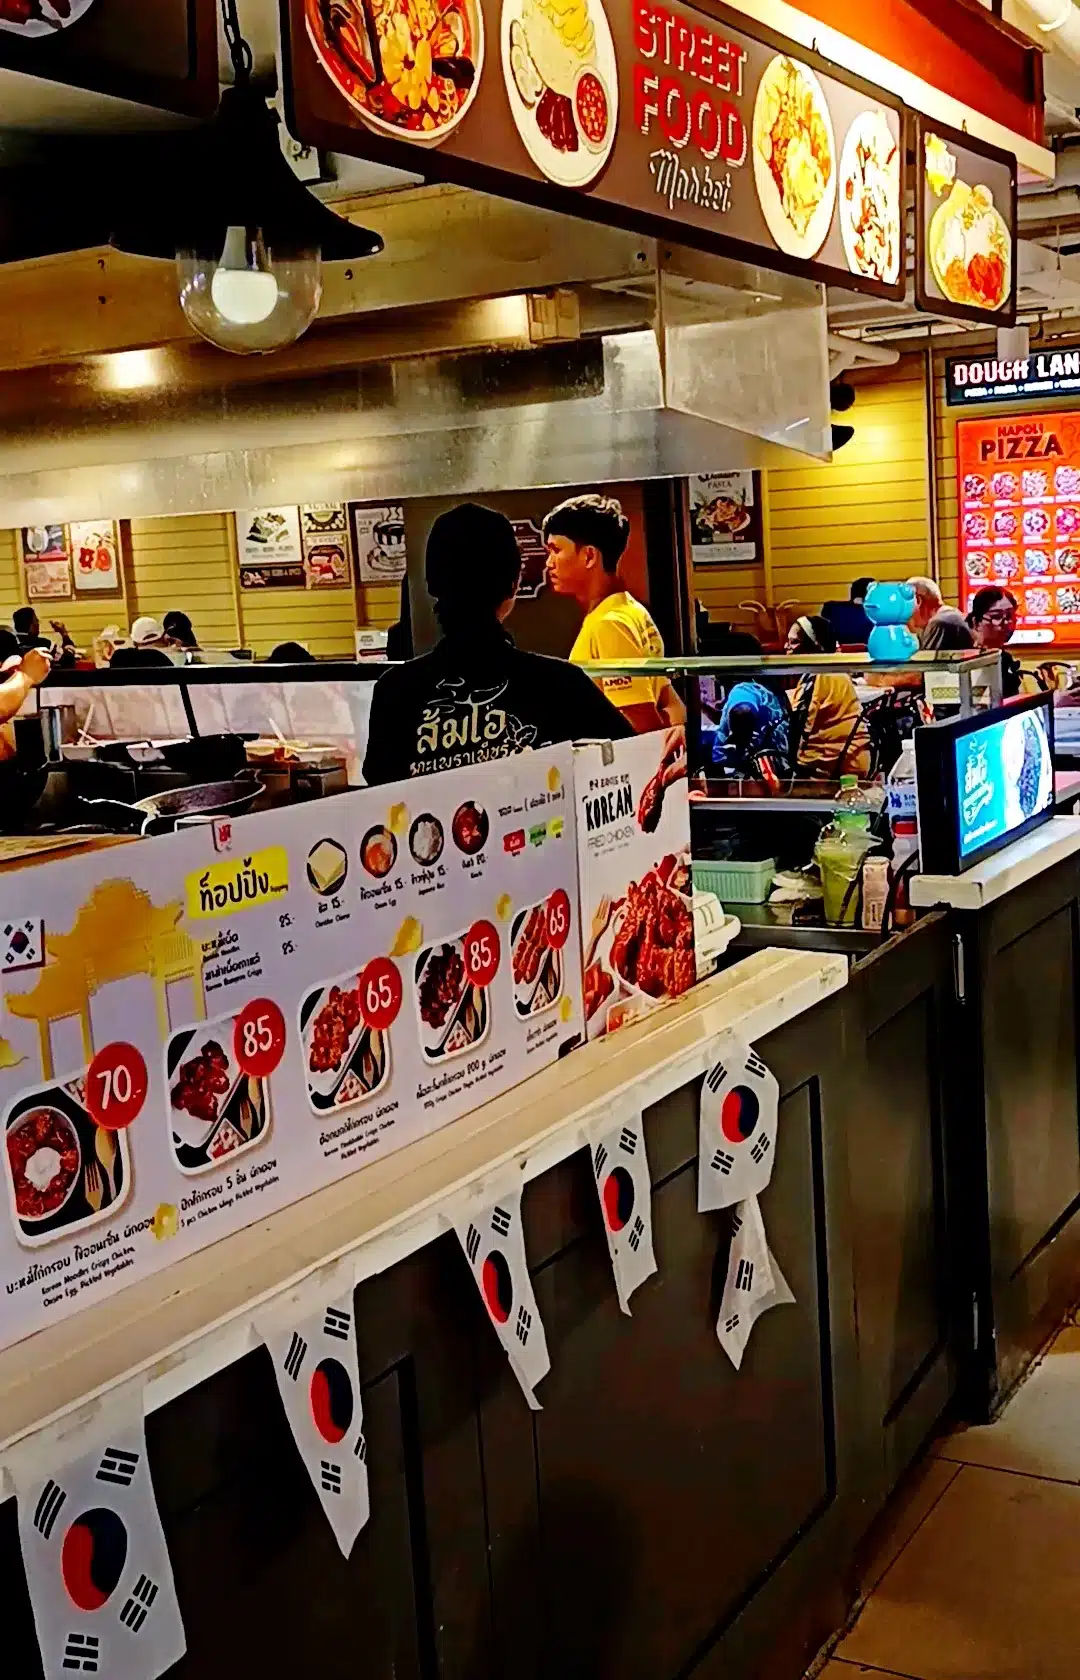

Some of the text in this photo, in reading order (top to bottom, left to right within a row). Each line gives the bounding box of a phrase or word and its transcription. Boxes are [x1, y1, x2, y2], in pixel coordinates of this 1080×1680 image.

[633, 0, 748, 97] STREET
[633, 64, 748, 168] FOOD
[954, 360, 1029, 386] DOUGH
[981, 434, 1064, 461] PIZZA
[998, 424, 1043, 438] NAPOLI
[416, 703, 507, 754] ส้มโอ
[586, 784, 634, 832] KOREAN
[199, 856, 269, 912] ท็อปปิ้ง
[226, 1175, 233, 1189] 5
[6, 1256, 72, 1294] บะหมี่ไก่กรอบ
[41, 1281, 63, 1295] Korean
